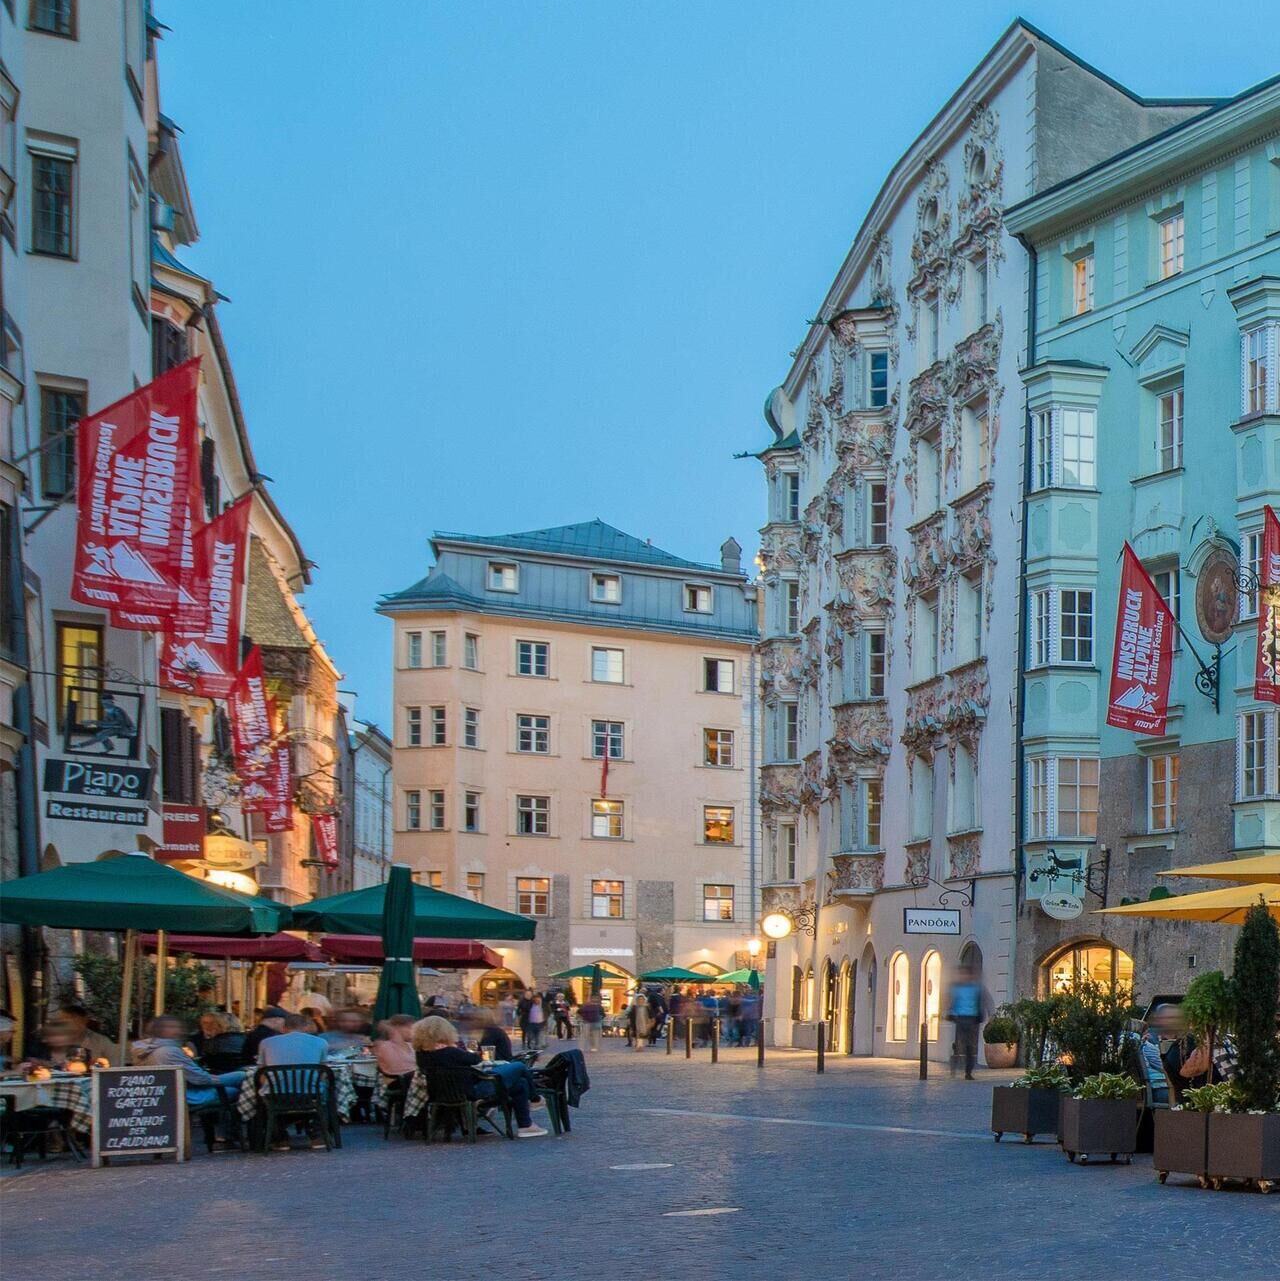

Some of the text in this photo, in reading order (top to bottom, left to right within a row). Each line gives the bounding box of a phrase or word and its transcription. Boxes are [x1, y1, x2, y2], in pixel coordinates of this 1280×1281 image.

[1116, 588, 1142, 681] INNSBRUCK
[1133, 625, 1154, 684] ALPINE
[62, 762, 139, 793] Piano
[120, 790, 138, 799] Bar
[50, 803, 145, 823] Restaurant
[120, 1075, 156, 1087] PIANO
[106, 1085, 167, 1098] ROMANTIK
[114, 1097, 160, 1109] GARTEN
[107, 1115, 167, 1129] INNENHOF
[128, 1127, 147, 1136] DER
[105, 1135, 170, 1149] CLAUDIANA
